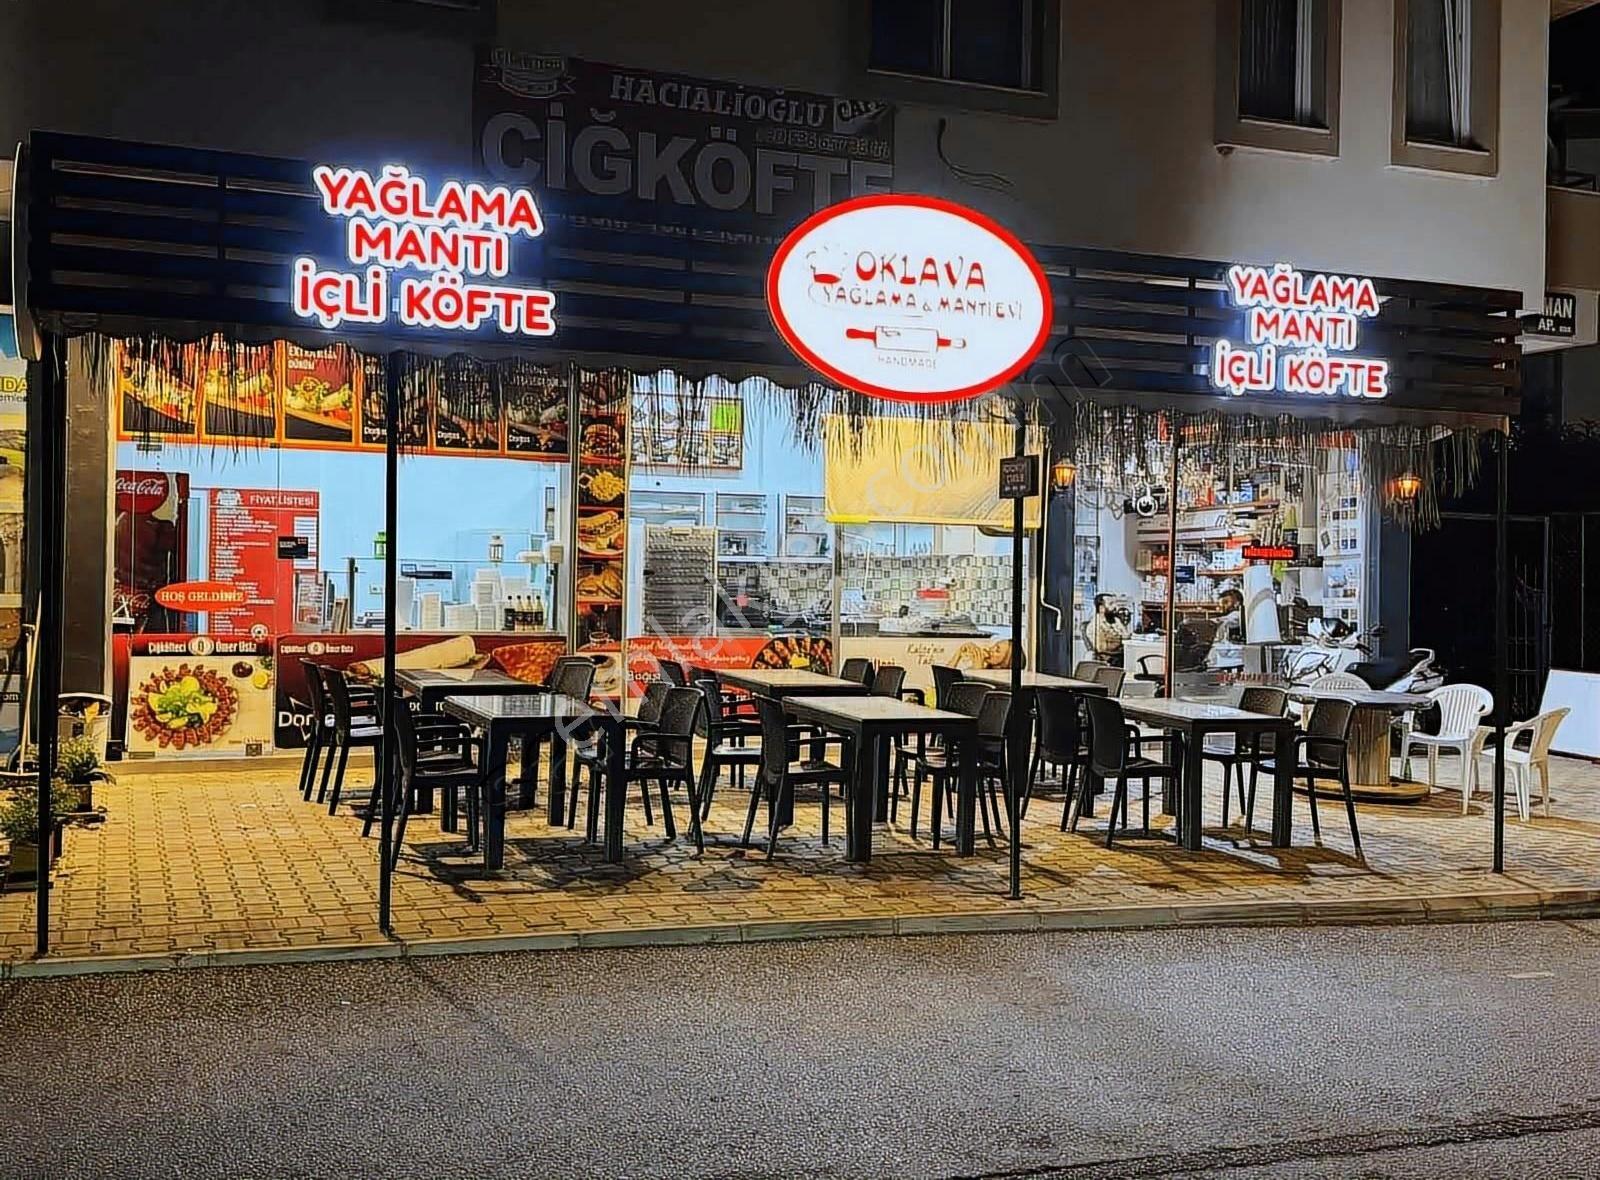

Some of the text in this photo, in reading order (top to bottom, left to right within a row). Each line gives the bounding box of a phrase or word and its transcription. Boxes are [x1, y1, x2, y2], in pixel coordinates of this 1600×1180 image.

[318, 171, 538, 231] YAĞLAMA
[354, 223, 503, 272] MANTI
[855, 250, 986, 292] OKLAVA
[1234, 268, 1376, 312] YAĞLAMA
[299, 263, 551, 331] İÇLİ KÖFTE
[1256, 312, 1352, 346] MANTI
[0, 376, 27, 392] DA
[1218, 345, 1383, 394] İÇLİ KÖFTE
[249, 494, 314, 507] FİYAT LİSTESİ
[161, 590, 185, 604] HOŞ
